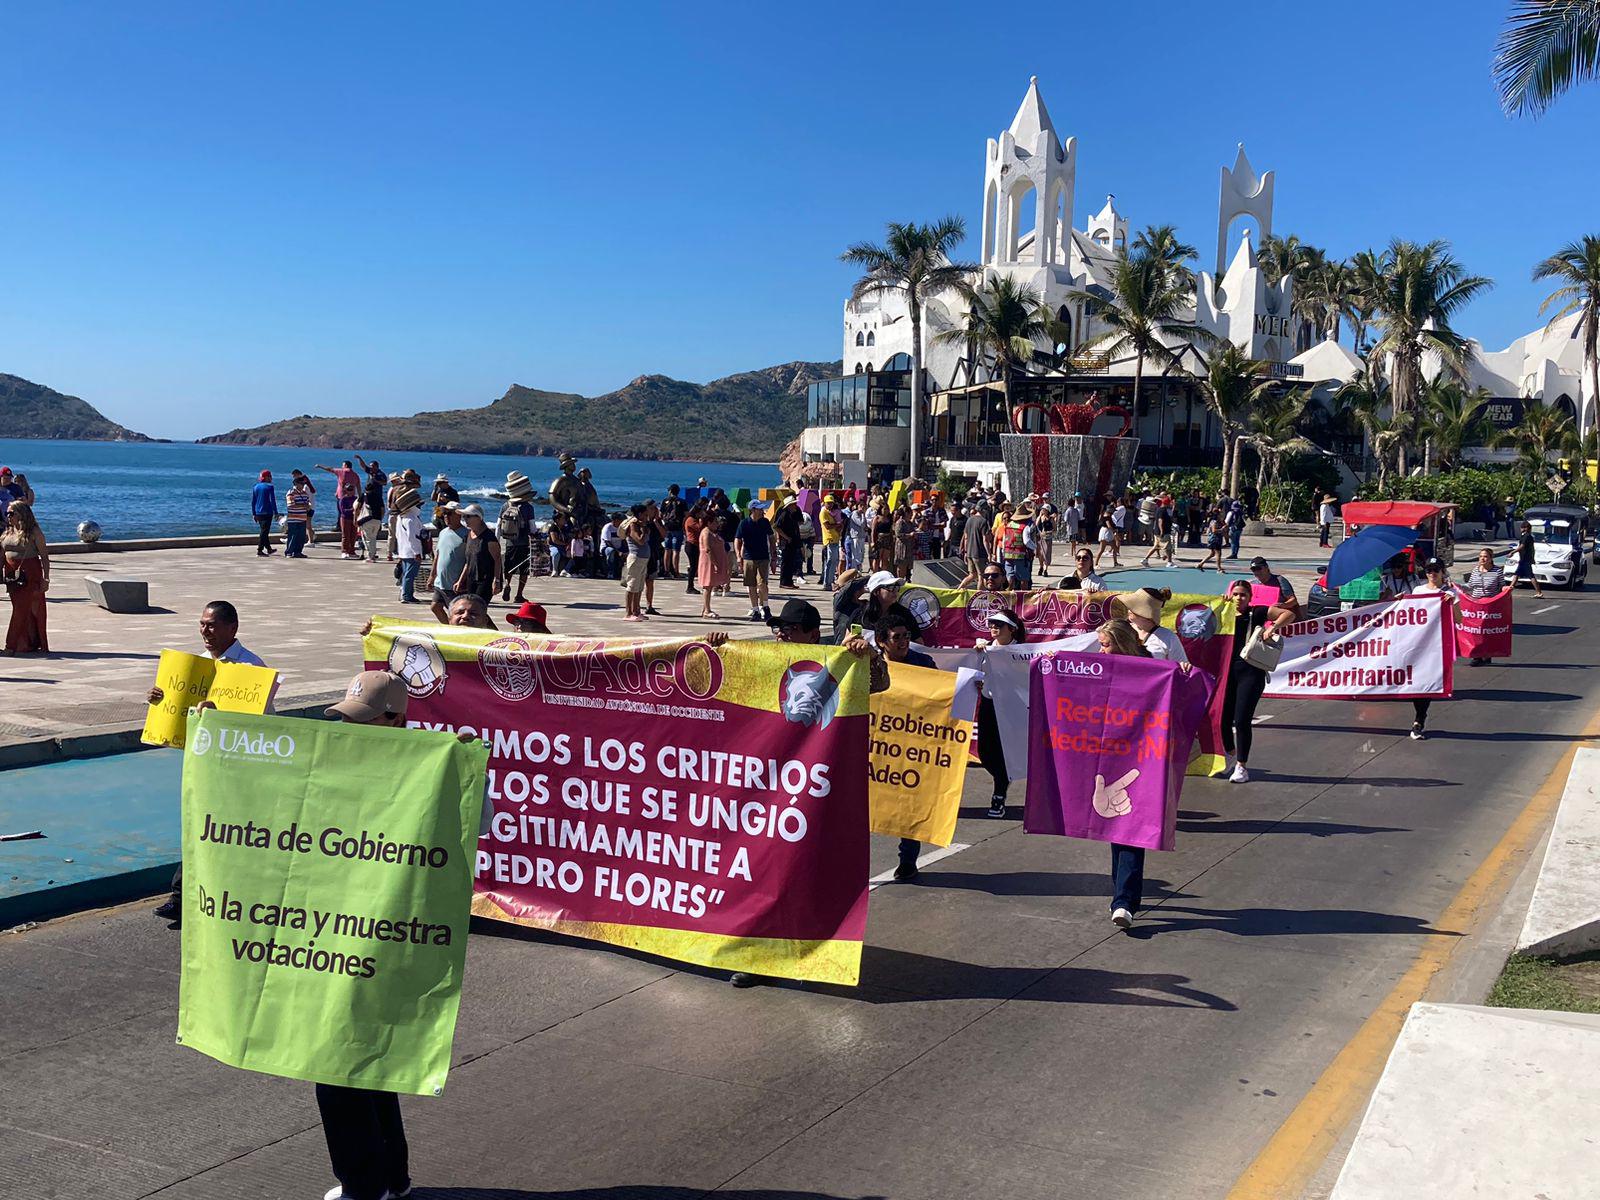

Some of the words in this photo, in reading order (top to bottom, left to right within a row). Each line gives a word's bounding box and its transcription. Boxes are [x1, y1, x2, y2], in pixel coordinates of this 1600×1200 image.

[1487, 405, 1512, 413] NEW
[1323, 616, 1348, 634] se
[1353, 606, 1428, 630] respete
[1477, 611, 1502, 620] Flores
[1310, 642, 1328, 659] el
[1332, 637, 1391, 659] sentir
[542, 640, 724, 700] UAdeO
[1056, 659, 1103, 675] UAdeO
[1288, 665, 1413, 688] mayoritario!
[168, 674, 185, 692] No
[163, 700, 177, 714] No
[671, 706, 725, 722] OCCIDENTE
[1057, 697, 1139, 727] Rector
[880, 714, 967, 743] gobierno
[219, 729, 295, 757] UAdeO
[584, 736, 646, 773] LOS
[657, 746, 831, 798] CRITERIOS
[906, 747, 930, 763] en
[935, 747, 951, 768] la
[488, 769, 550, 805] LOS
[562, 777, 630, 815] QUE
[641, 786, 677, 822] SE
[689, 793, 808, 843] UNGIÓ
[200, 814, 271, 849] Junta
[277, 822, 313, 853] de
[319, 827, 448, 868] Gobierno
[478, 804, 721, 875] GÍTIMAMENTE
[727, 846, 752, 881] A
[475, 850, 584, 893] PEDRO
[595, 866, 725, 919] FLORES"
[199, 885, 215, 917] Da
[221, 891, 242, 921] la
[249, 903, 307, 929] cara
[313, 911, 331, 938] y
[333, 913, 451, 946] muestra
[232, 938, 376, 979] votaciones
